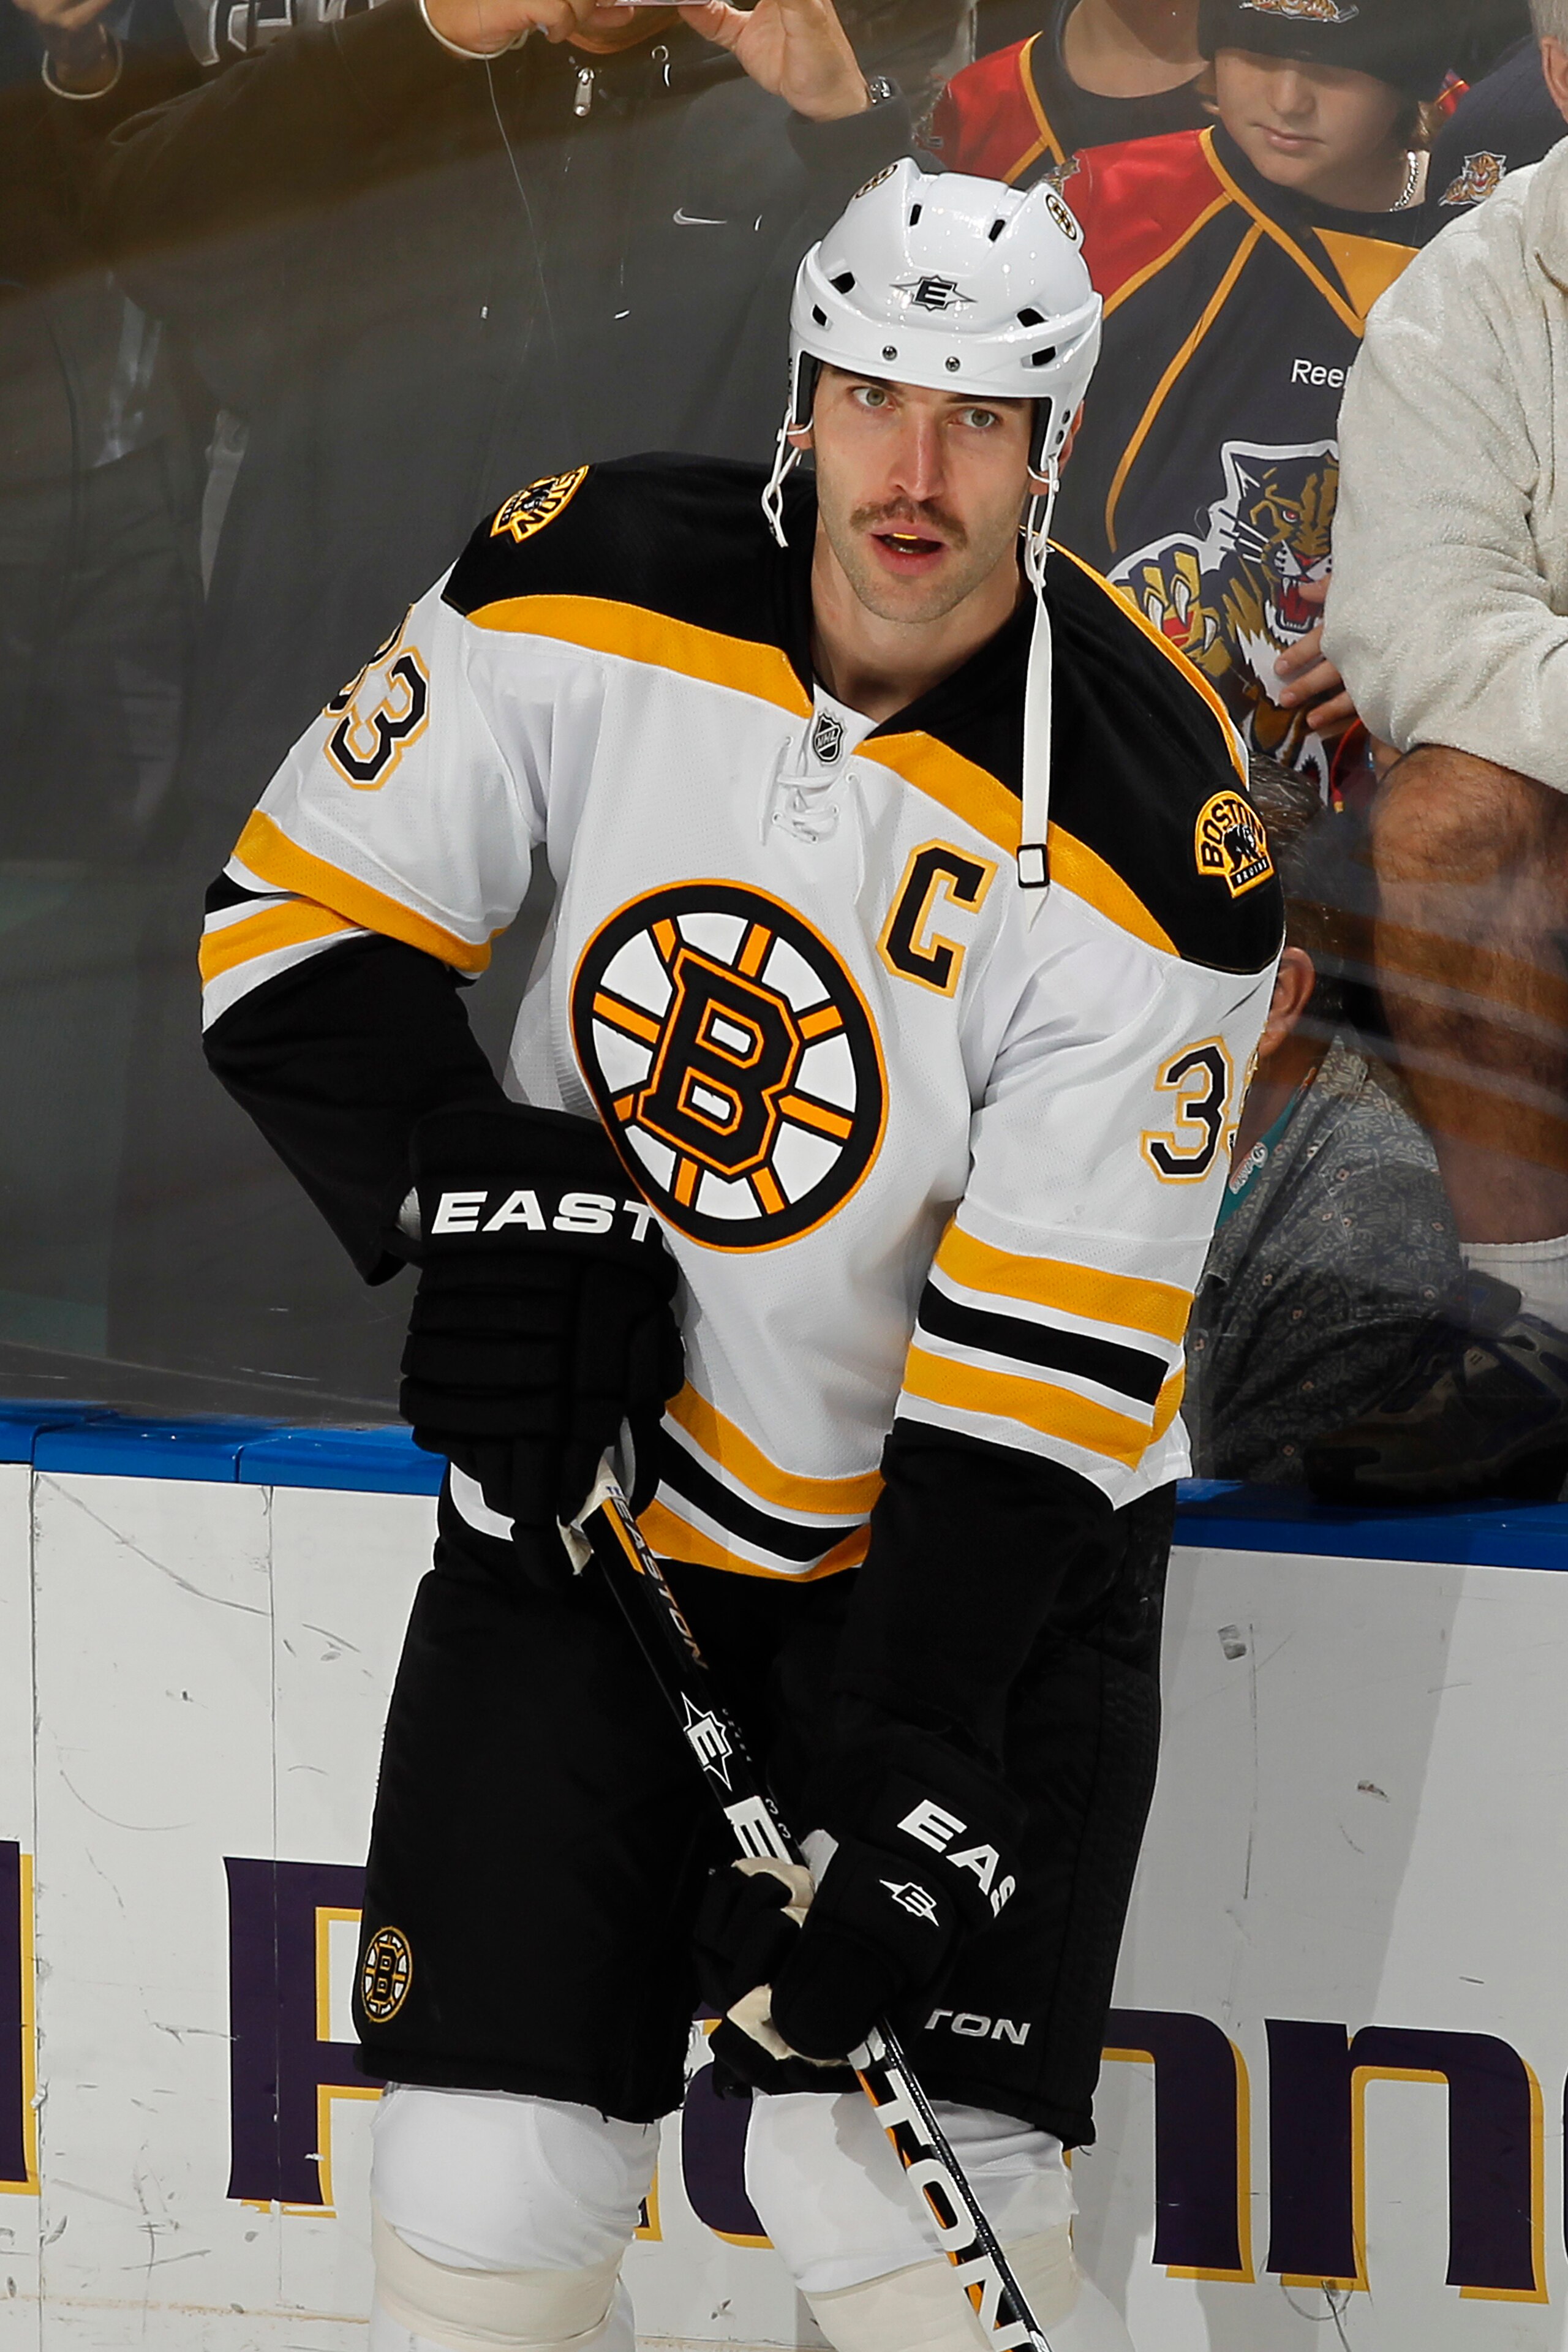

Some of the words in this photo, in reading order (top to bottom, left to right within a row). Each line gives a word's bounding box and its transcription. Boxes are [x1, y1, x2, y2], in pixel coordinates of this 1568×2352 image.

[1200, 798, 1264, 868] BOSTON
[875, 837, 999, 998] C
[636, 948, 800, 1175] B
[1139, 1033, 1259, 1186] 3
